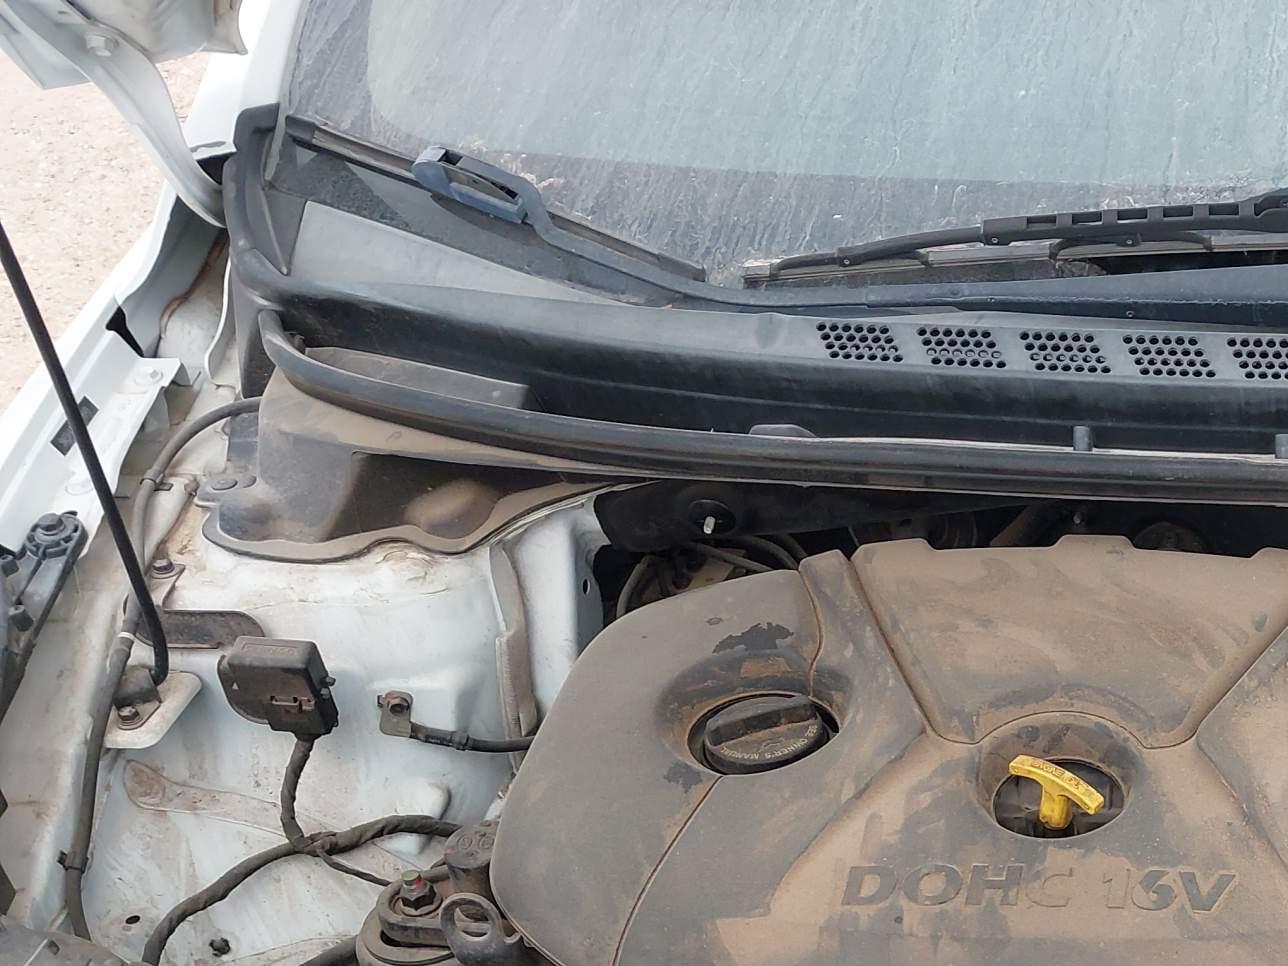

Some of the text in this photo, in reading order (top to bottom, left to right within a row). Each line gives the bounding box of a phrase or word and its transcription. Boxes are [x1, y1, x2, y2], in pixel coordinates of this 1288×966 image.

[764, 738, 807, 759] OWNER'S
[841, 862, 1239, 913] DOHC 16V
